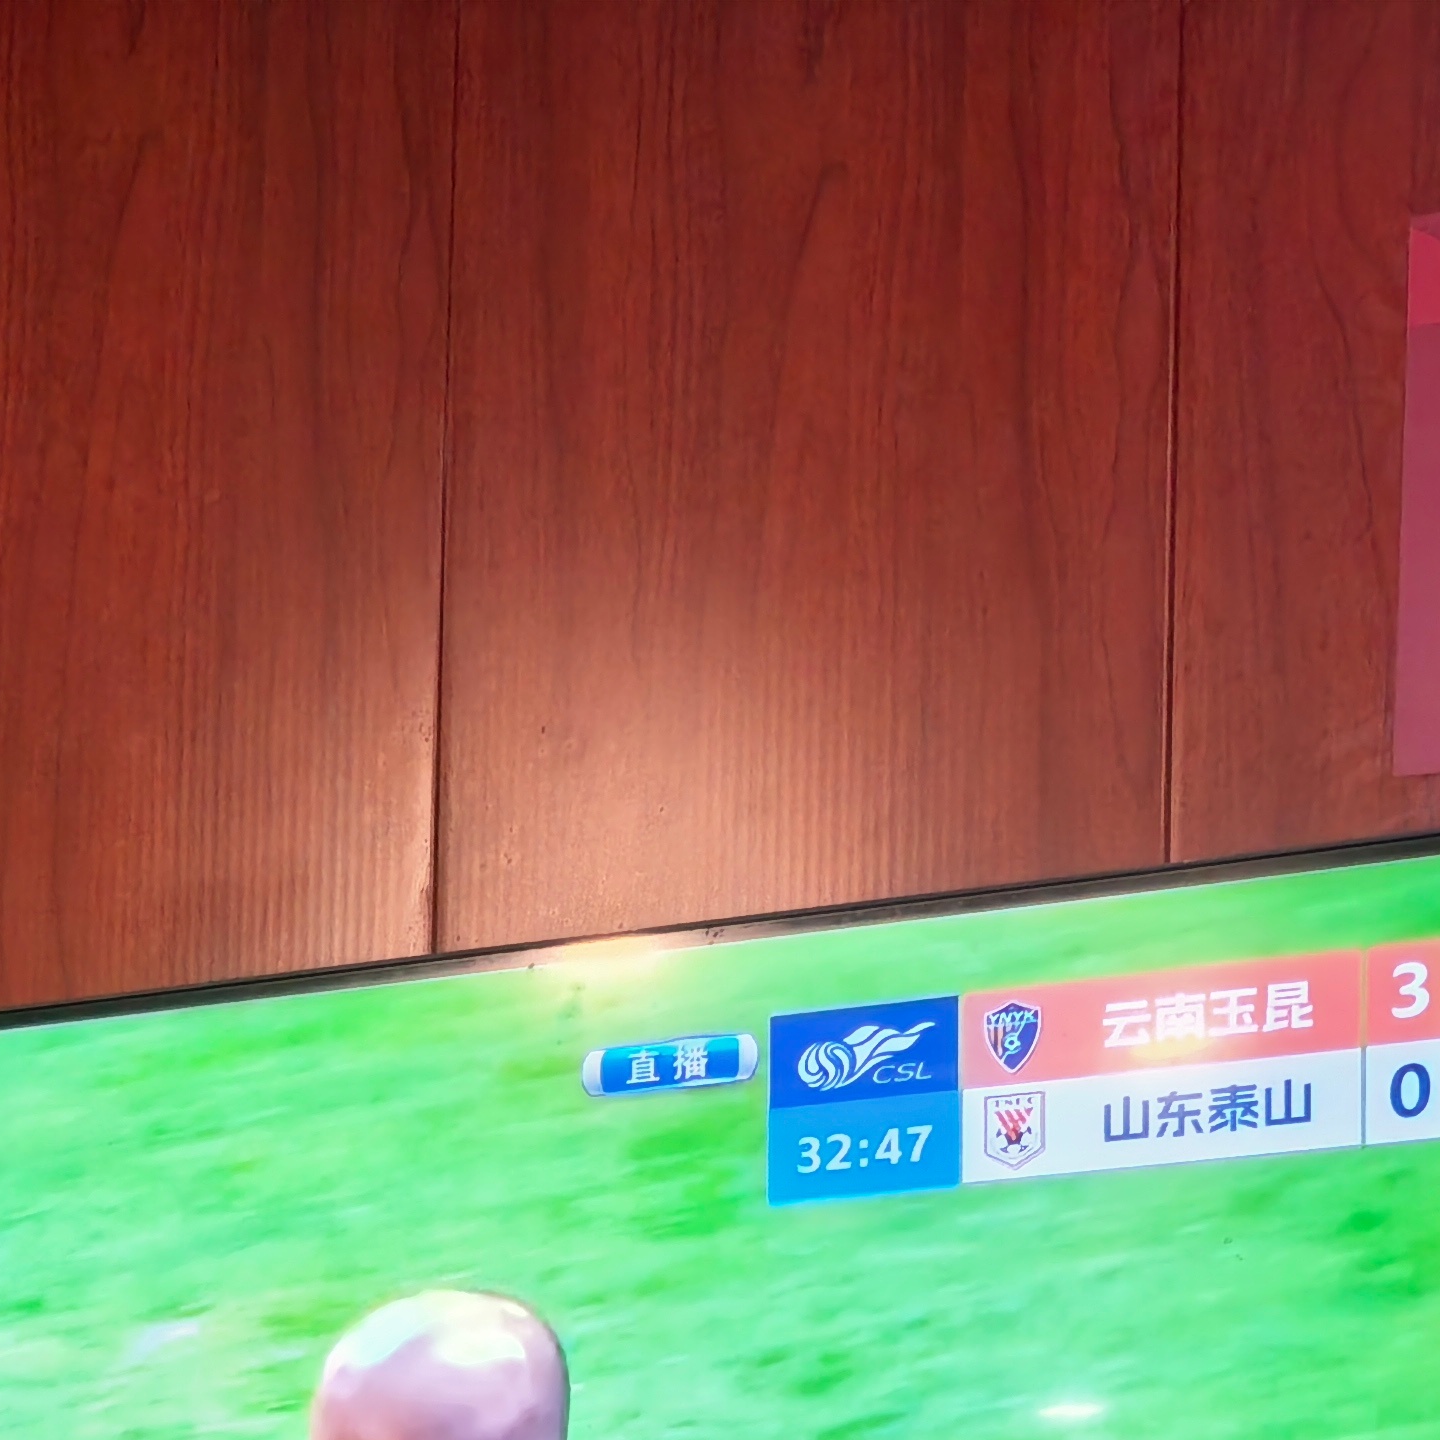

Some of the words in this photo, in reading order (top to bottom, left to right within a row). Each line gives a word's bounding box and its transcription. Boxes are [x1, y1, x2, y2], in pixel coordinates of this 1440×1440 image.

[1103, 980, 1314, 1048] 云南玉昆
[1390, 961, 1431, 1020] 3
[625, 1044, 710, 1085] 直播
[872, 1061, 933, 1084] CSL
[1389, 1062, 1432, 1119] 0
[1103, 1078, 1313, 1143] 山东泰山
[796, 1124, 934, 1174] 32:47
